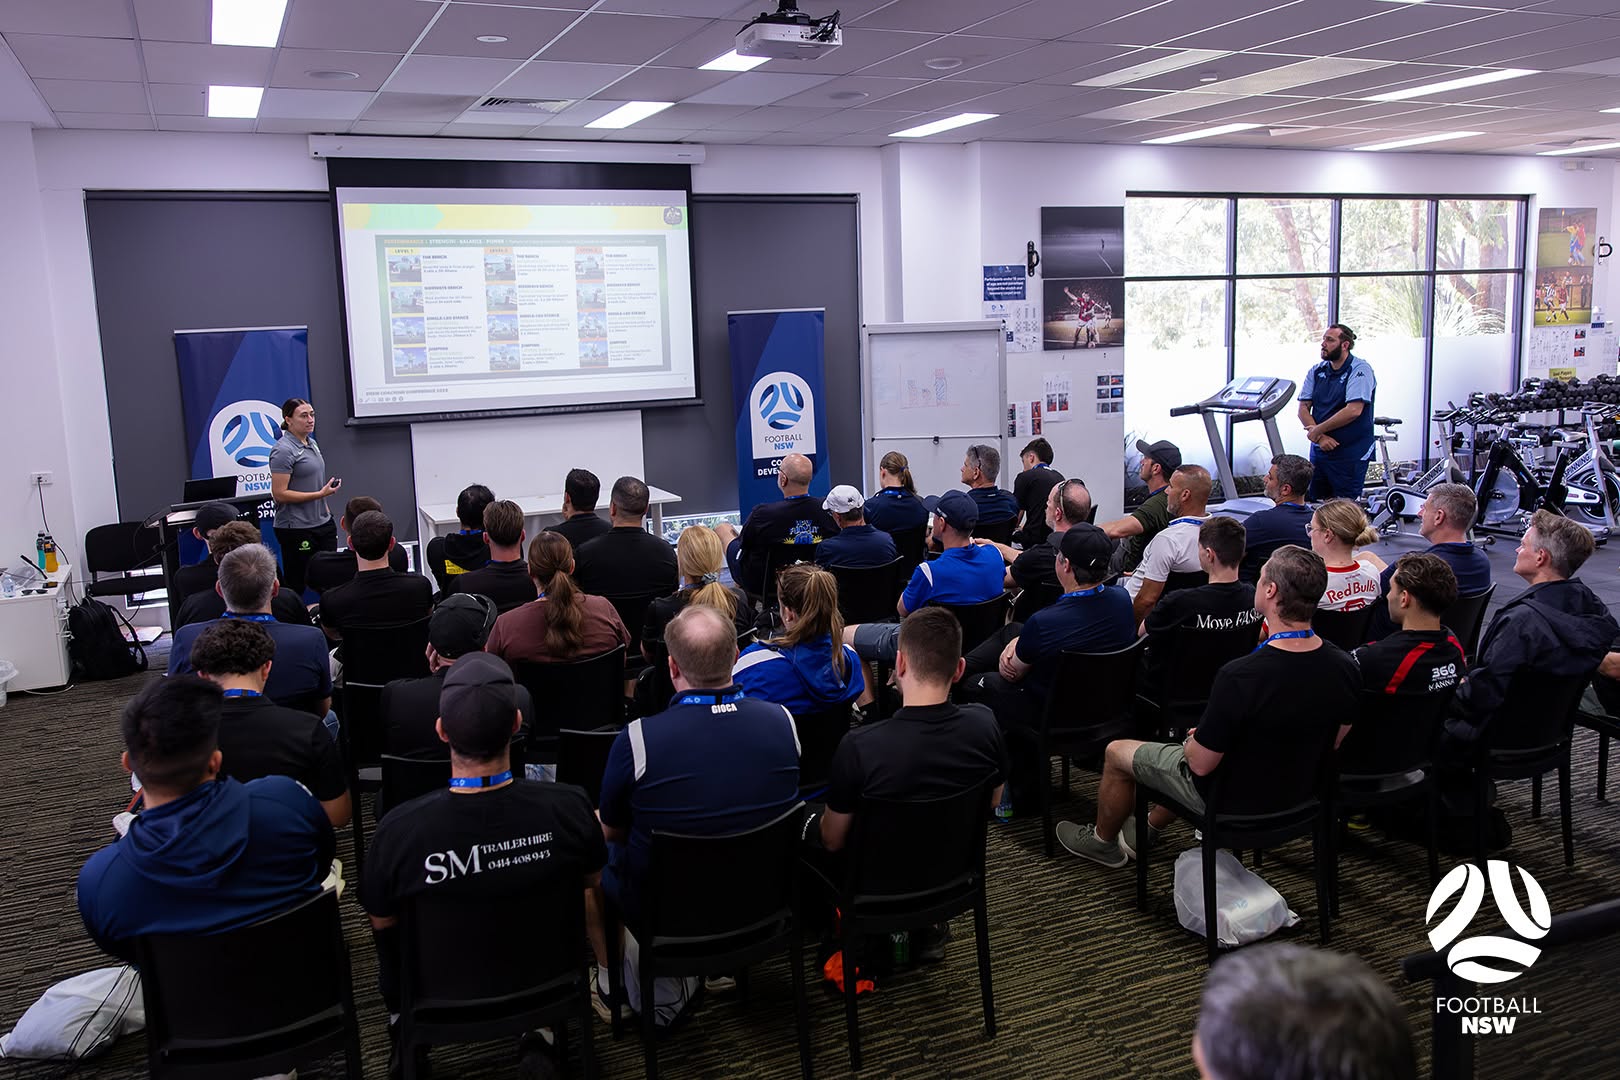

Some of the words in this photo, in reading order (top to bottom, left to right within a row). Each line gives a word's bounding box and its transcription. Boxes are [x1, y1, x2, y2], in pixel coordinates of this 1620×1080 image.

[764, 433, 802, 443] FOOTBALL
[774, 442, 794, 450] NSW
[245, 482, 270, 492] NSW
[1326, 582, 1352, 604] Red
[1353, 580, 1375, 594] Bulls
[1196, 614, 1234, 630] Move
[1432, 662, 1456, 678] 360
[711, 702, 738, 714] GIOCA
[480, 838, 527, 854] TRAILER
[527, 832, 552, 846] HIRE
[424, 844, 482, 884] SM
[488, 857, 511, 870] 0414
[511, 854, 532, 865] 408
[532, 849, 550, 860] 943
